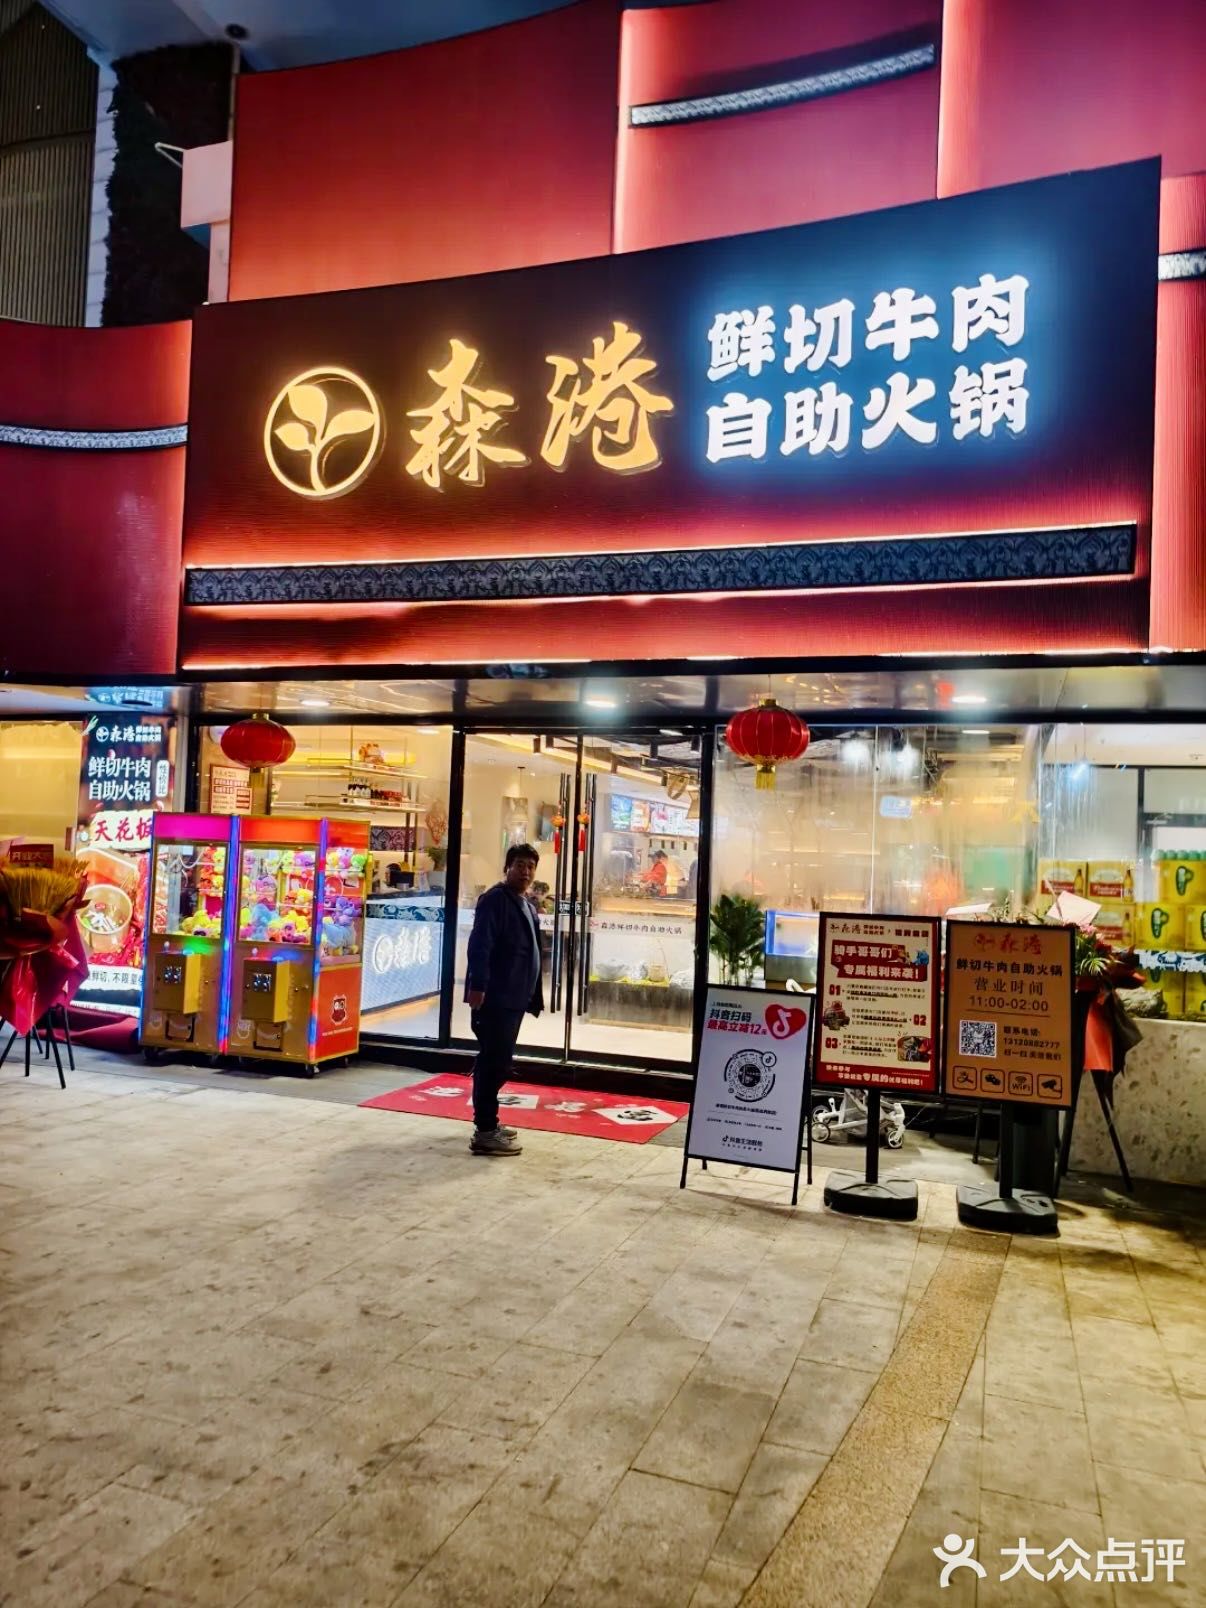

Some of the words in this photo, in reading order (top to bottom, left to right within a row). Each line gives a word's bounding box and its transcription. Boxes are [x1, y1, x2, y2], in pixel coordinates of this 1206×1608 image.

[707, 273, 1029, 381] 鲜切牛肉
[706, 358, 1029, 463] 自助火锅
[88, 757, 151, 777] 鲜切牛肉
[88, 780, 151, 801] 自助火锅
[601, 922, 682, 935] 森港鲜切牛肉自助火锅
[956, 958, 1062, 976] 鲜切牛肉自助火锅
[829, 984, 841, 996] 01
[975, 977, 1043, 996] 营业时间
[968, 995, 1049, 1012] 11:00-02:00
[709, 1008, 752, 1022] 抖音扫码
[913, 1014, 927, 1026] 02
[825, 1037, 838, 1049] 03
[1012, 1083, 1030, 1091] WiFi
